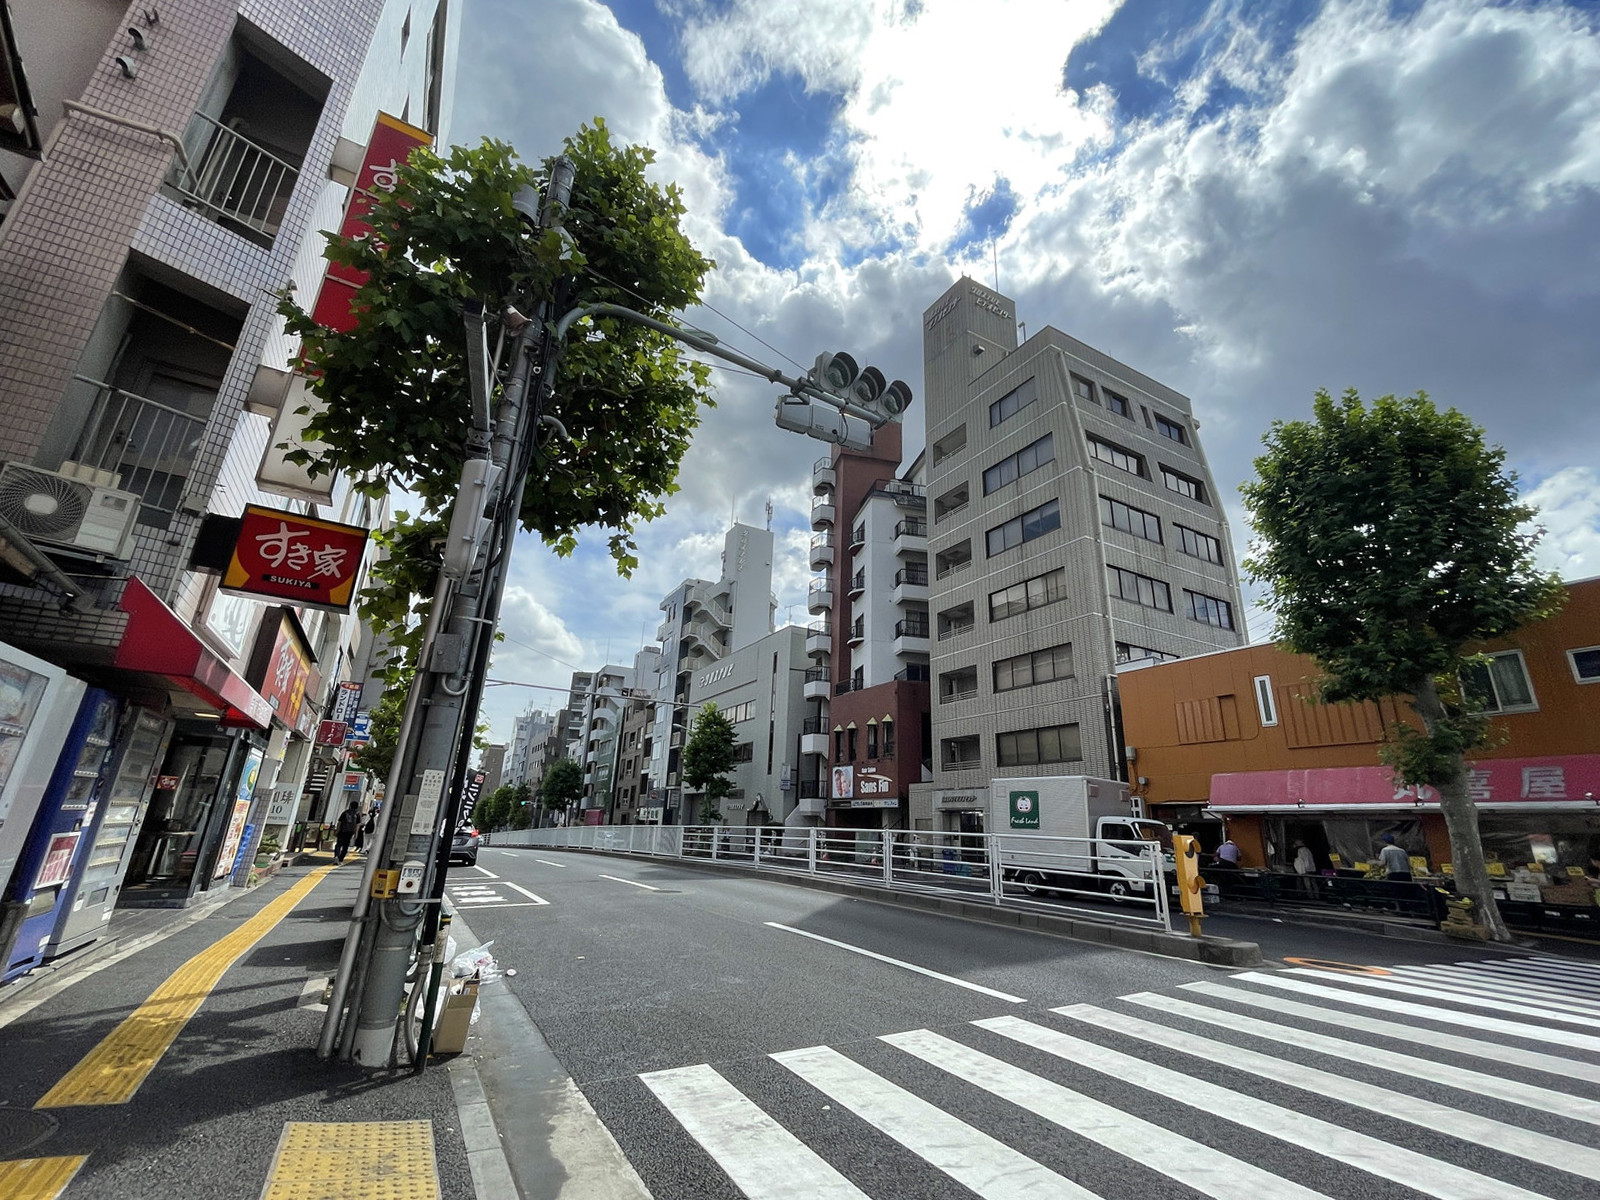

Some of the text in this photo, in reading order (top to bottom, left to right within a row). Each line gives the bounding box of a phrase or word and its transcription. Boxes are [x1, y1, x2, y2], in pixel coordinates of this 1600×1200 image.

[255, 521, 348, 580] すき家
[270, 575, 312, 588] SUKIYA
[860, 780, 877, 794] Sans
